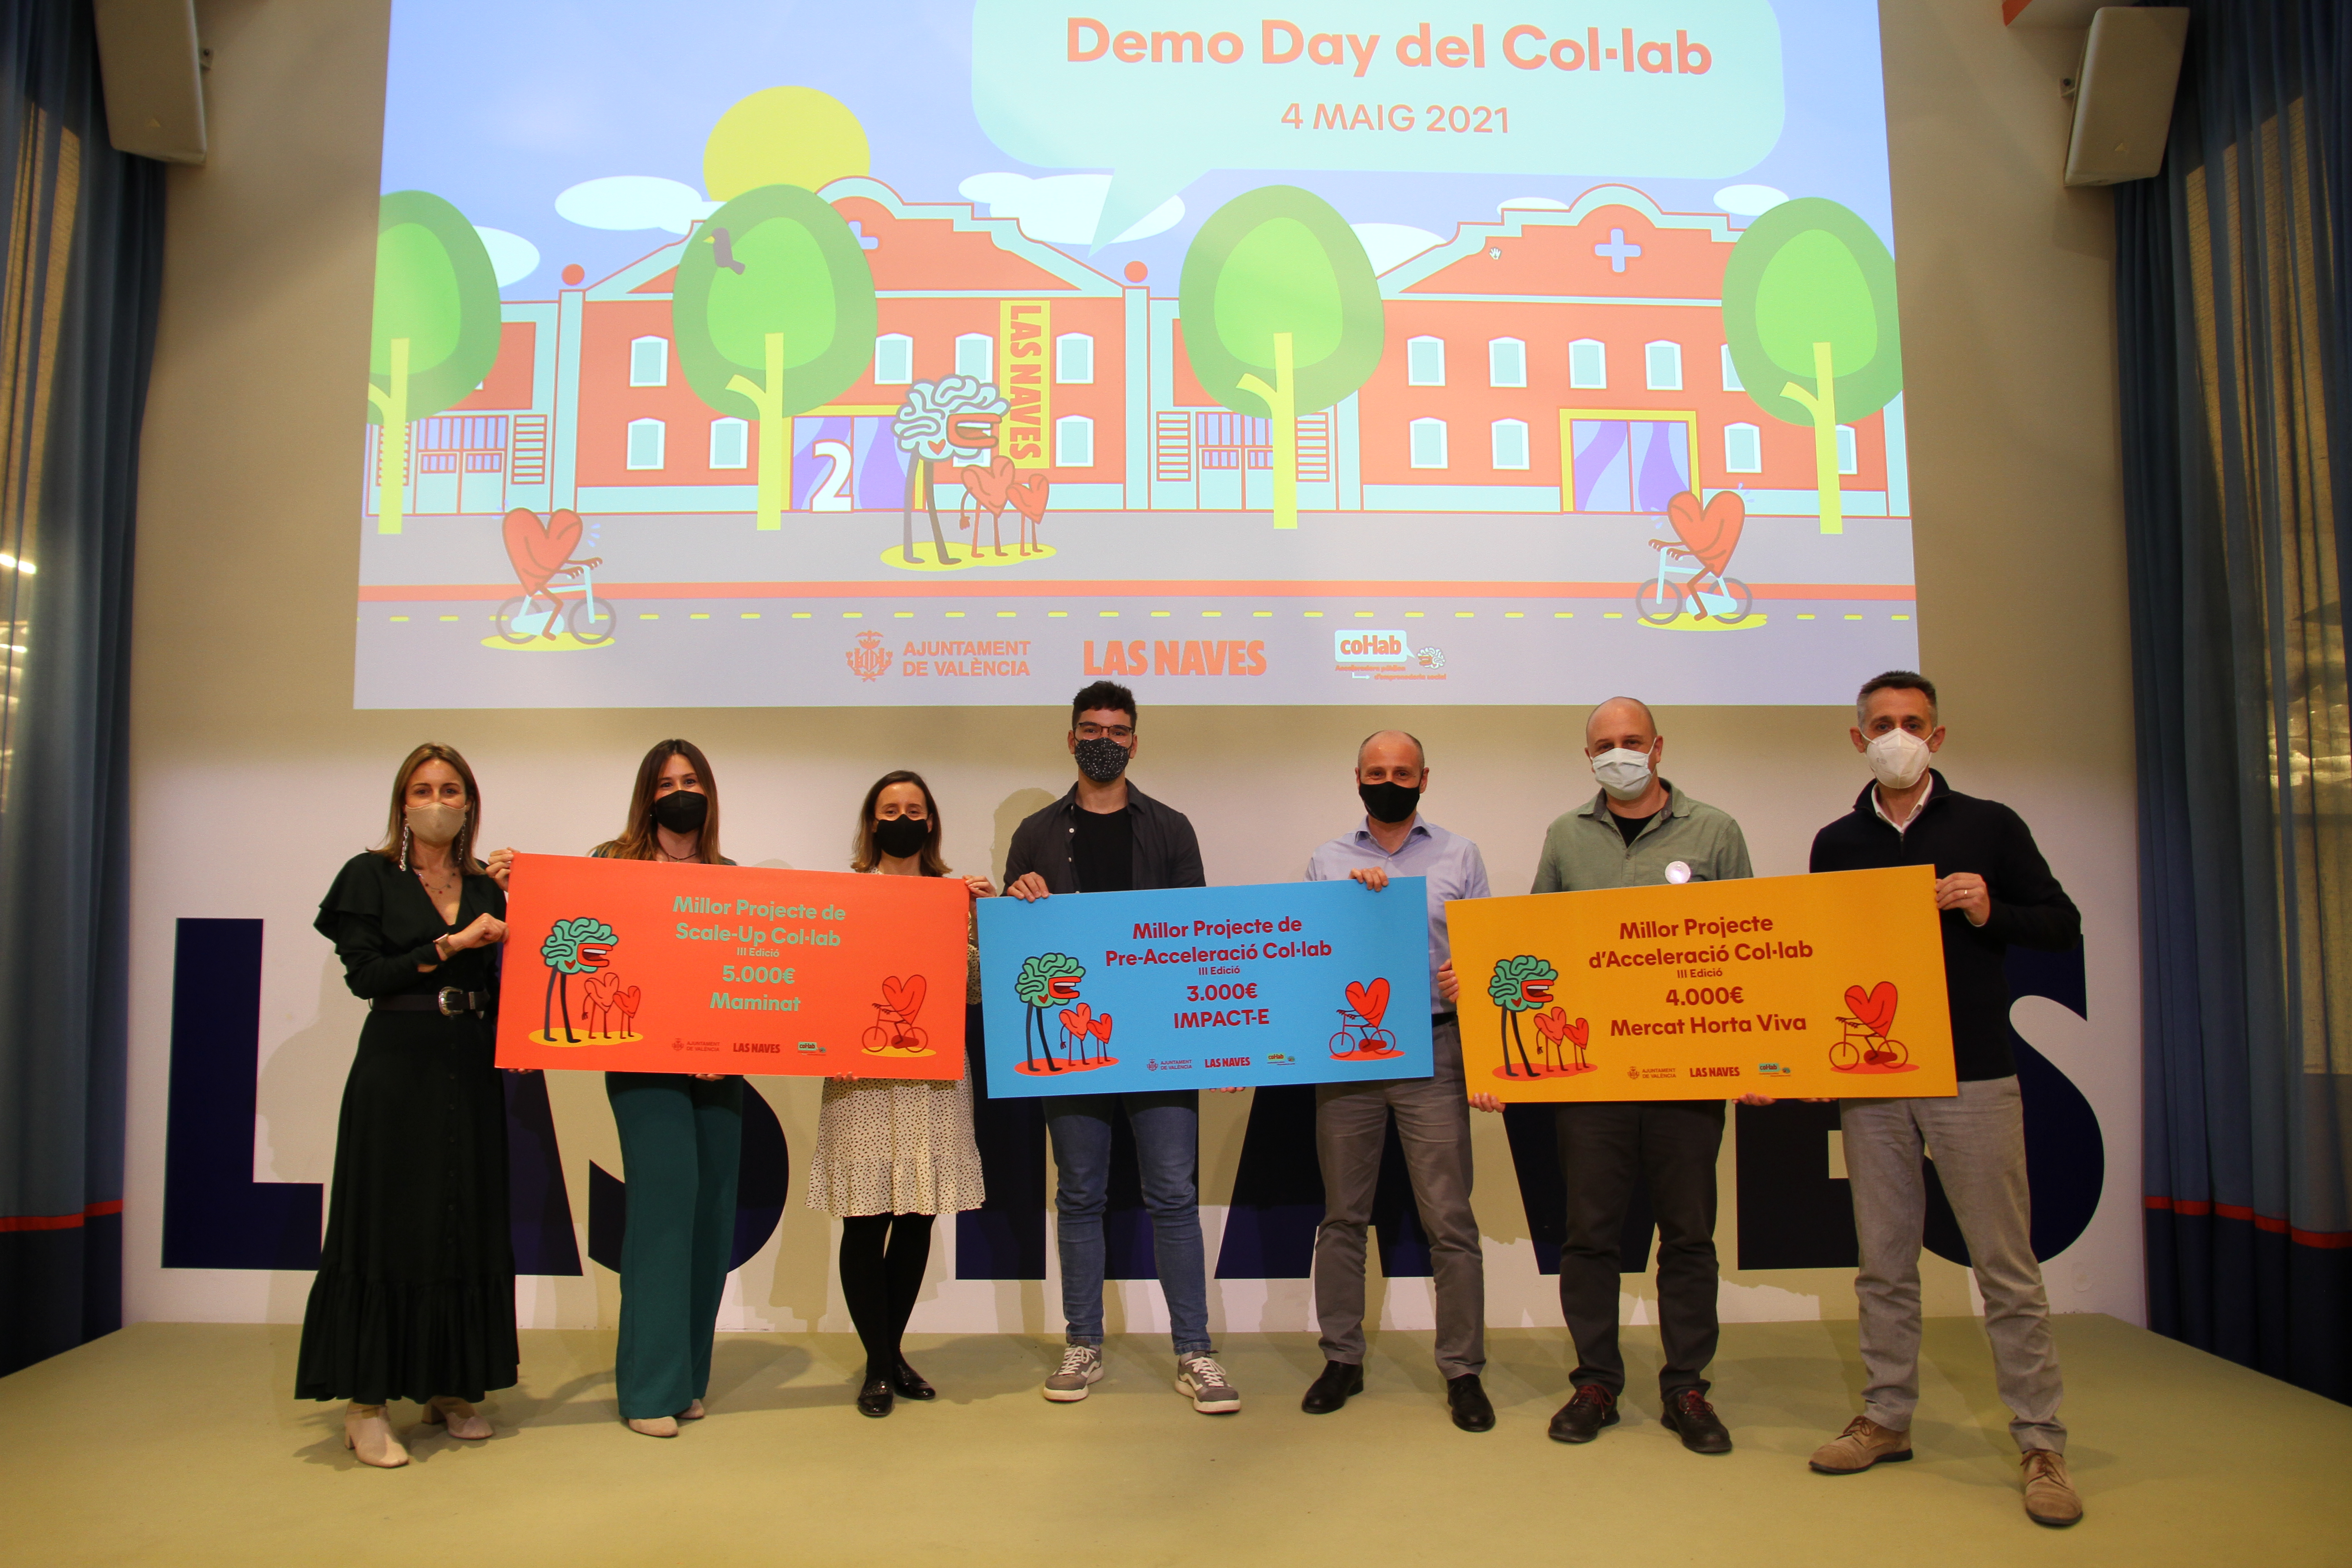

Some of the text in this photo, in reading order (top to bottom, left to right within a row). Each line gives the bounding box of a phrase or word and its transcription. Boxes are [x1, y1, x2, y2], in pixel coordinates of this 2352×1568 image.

[1068, 18, 1712, 77] Demo Day del Col·lab
[1282, 103, 1508, 133] 4 MAIG 2021
[1010, 306, 1041, 460] LAS NAVES
[811, 439, 854, 512] 2
[903, 641, 1031, 656] AJUNTAMENT
[1084, 640, 1266, 676] LAS NAVES
[903, 657, 1030, 676] DE VALÈNCIA
[673, 896, 845, 921] Millor Projecte de
[676, 923, 840, 946] Scale-Up Col·lab
[1133, 916, 1302, 939] Millor Projecte de
[1620, 916, 1774, 939] Millor Projecte
[737, 947, 779, 957] III Edició
[1106, 941, 1332, 966] Pre-Acceleració Col·lab
[1589, 941, 1813, 969] d'Acceleració Col·lab
[723, 965, 795, 984] 5.000€
[1210, 966, 1240, 975] Edició
[1677, 968, 1723, 978] III Edició
[710, 992, 801, 1011] Maminat
[1187, 983, 1258, 1001] 3.000€
[1666, 986, 1744, 1005] 4.000€
[1174, 1009, 1269, 1028] IMPACT-E
[1611, 1014, 1806, 1036] Mercat Horta Viva
[733, 1043, 780, 1053] LAS NAVES
[1205, 1057, 1250, 1068] LAS NAVES
[1690, 1067, 1740, 1077] LAS NAVES
